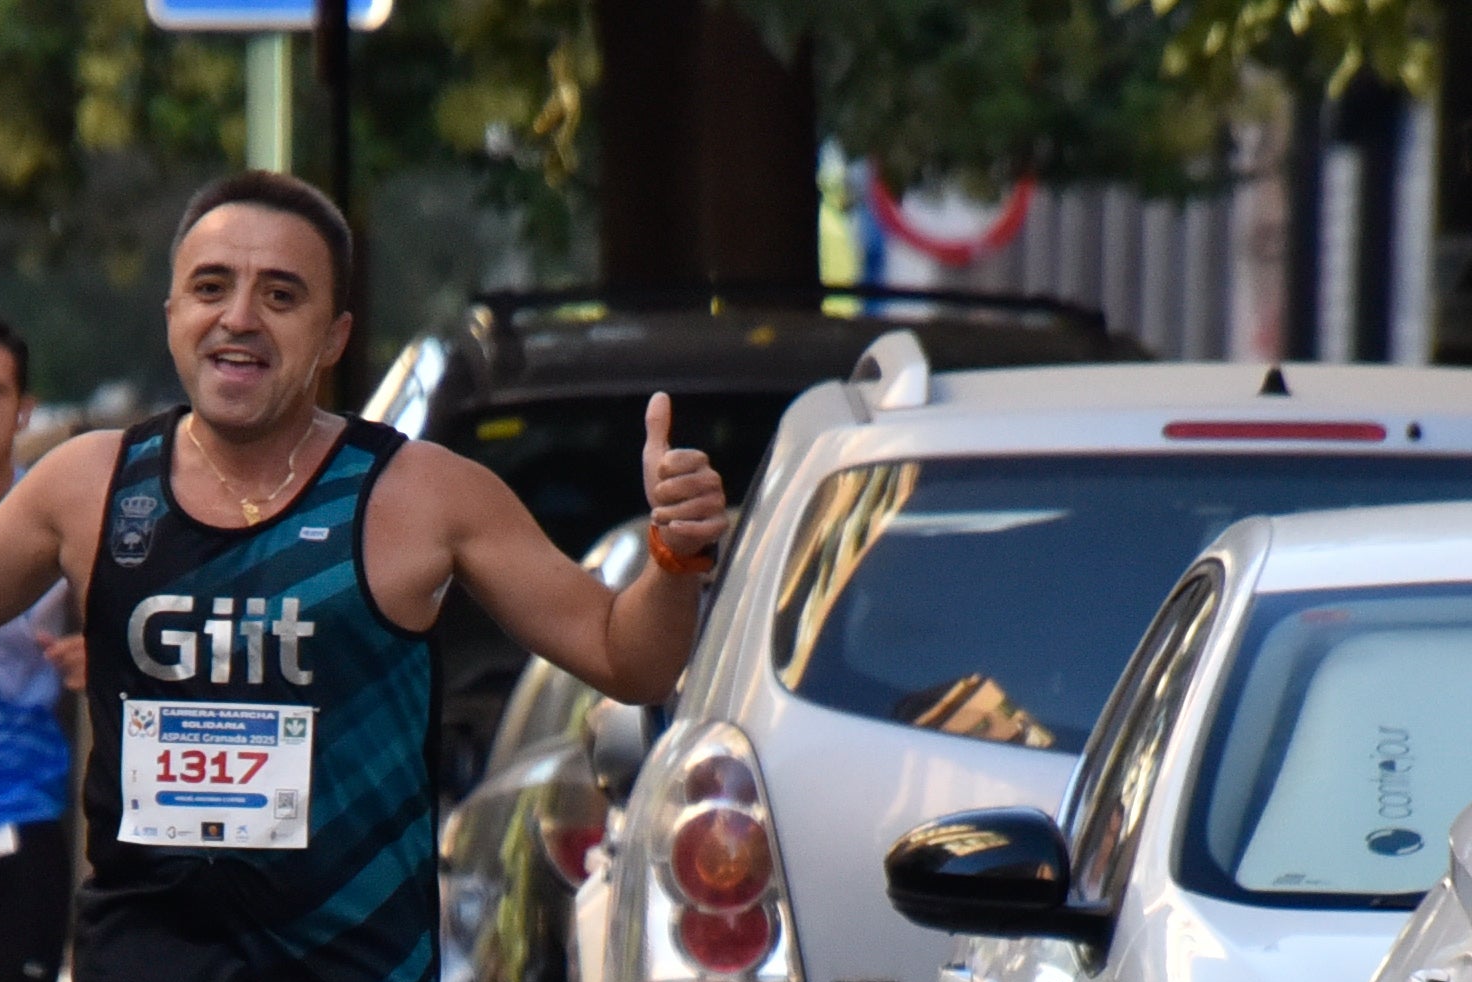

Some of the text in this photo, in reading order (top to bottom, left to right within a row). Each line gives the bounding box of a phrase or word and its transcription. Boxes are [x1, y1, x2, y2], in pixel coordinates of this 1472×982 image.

[127, 594, 315, 686] Giit
[181, 721, 246, 730] SOLIDARIA
[161, 732, 200, 742] ASPACE
[202, 733, 247, 744] Granada
[249, 735, 276, 745] 2025
[156, 749, 269, 785] 1317
